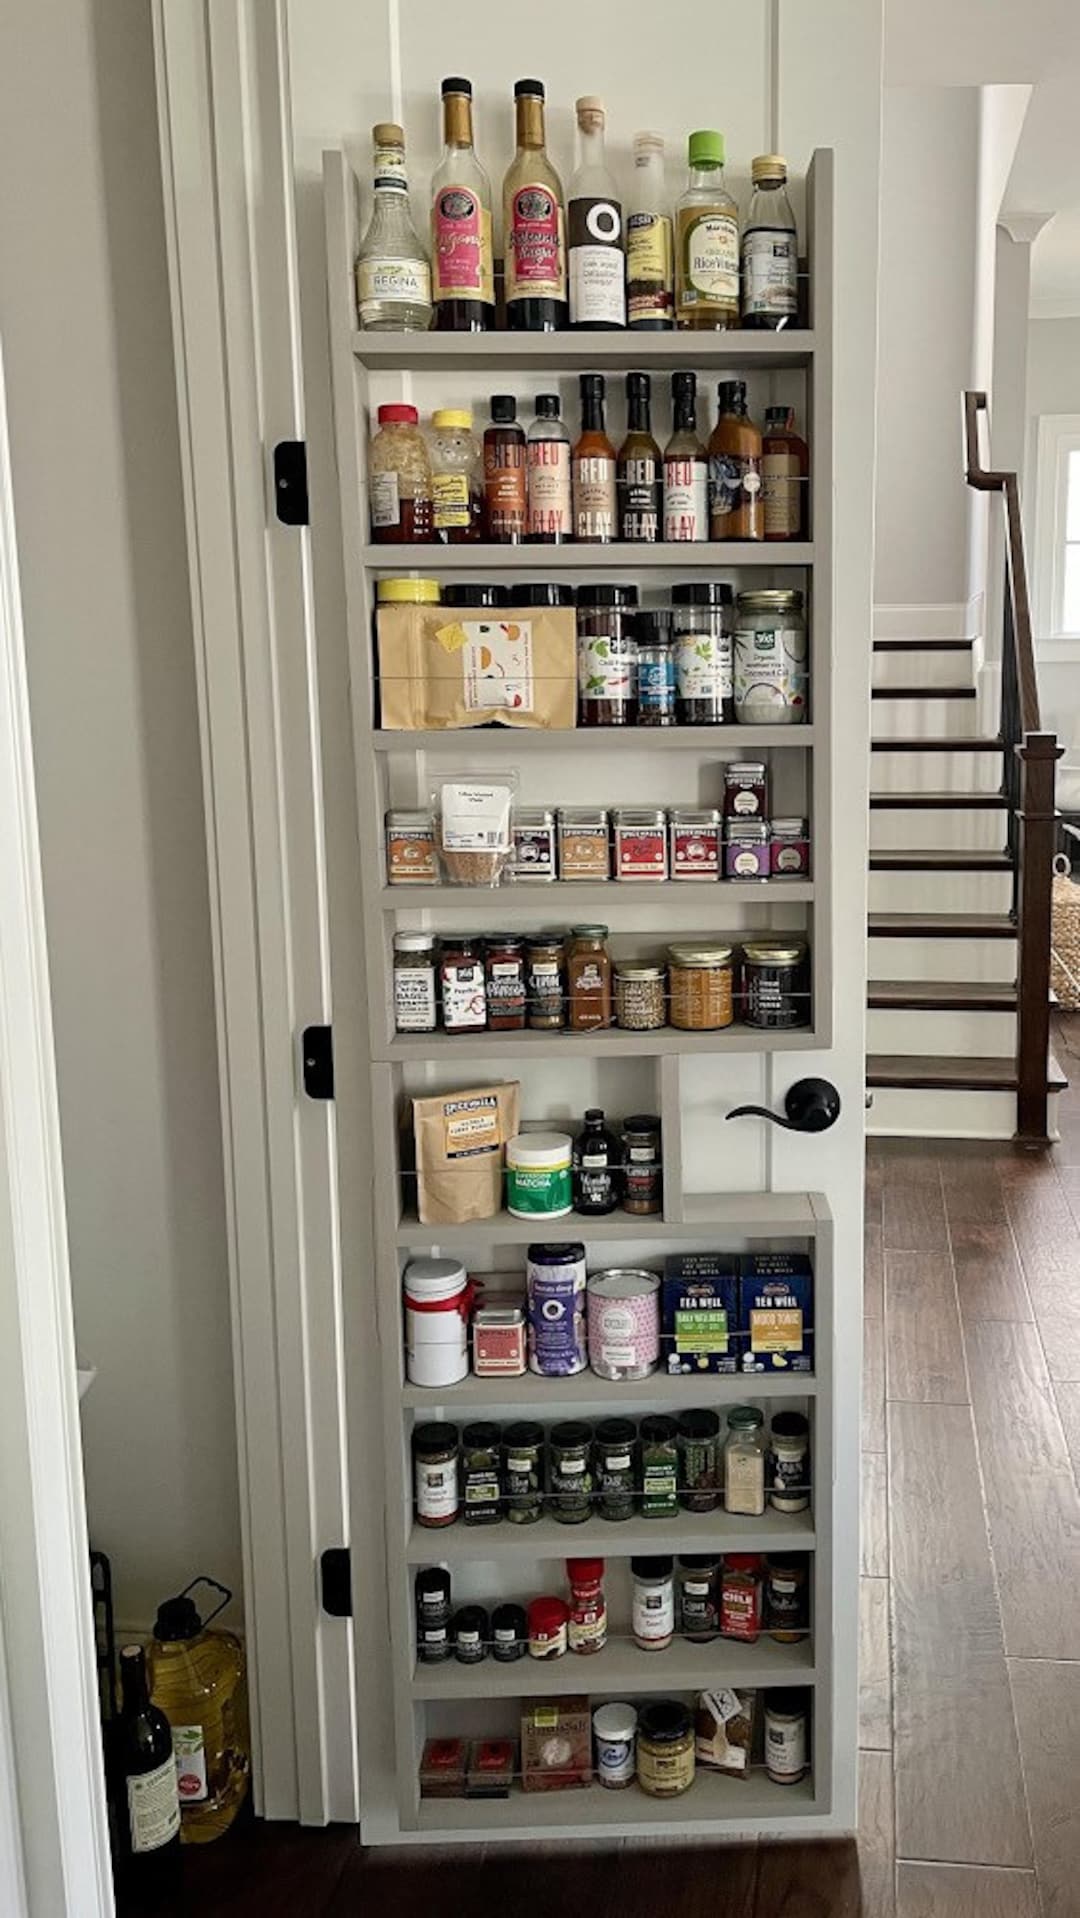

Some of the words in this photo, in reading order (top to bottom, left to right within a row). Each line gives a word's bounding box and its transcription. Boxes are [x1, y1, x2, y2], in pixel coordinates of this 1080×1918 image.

[373, 275, 419, 287] REGINA
[579, 457, 609, 485] RED
[626, 458, 656, 485] RED
[666, 461, 693, 488] RED
[578, 512, 612, 537] CLAY
[623, 513, 658, 538] CLAY
[515, 1178, 553, 1188] MATCHA
